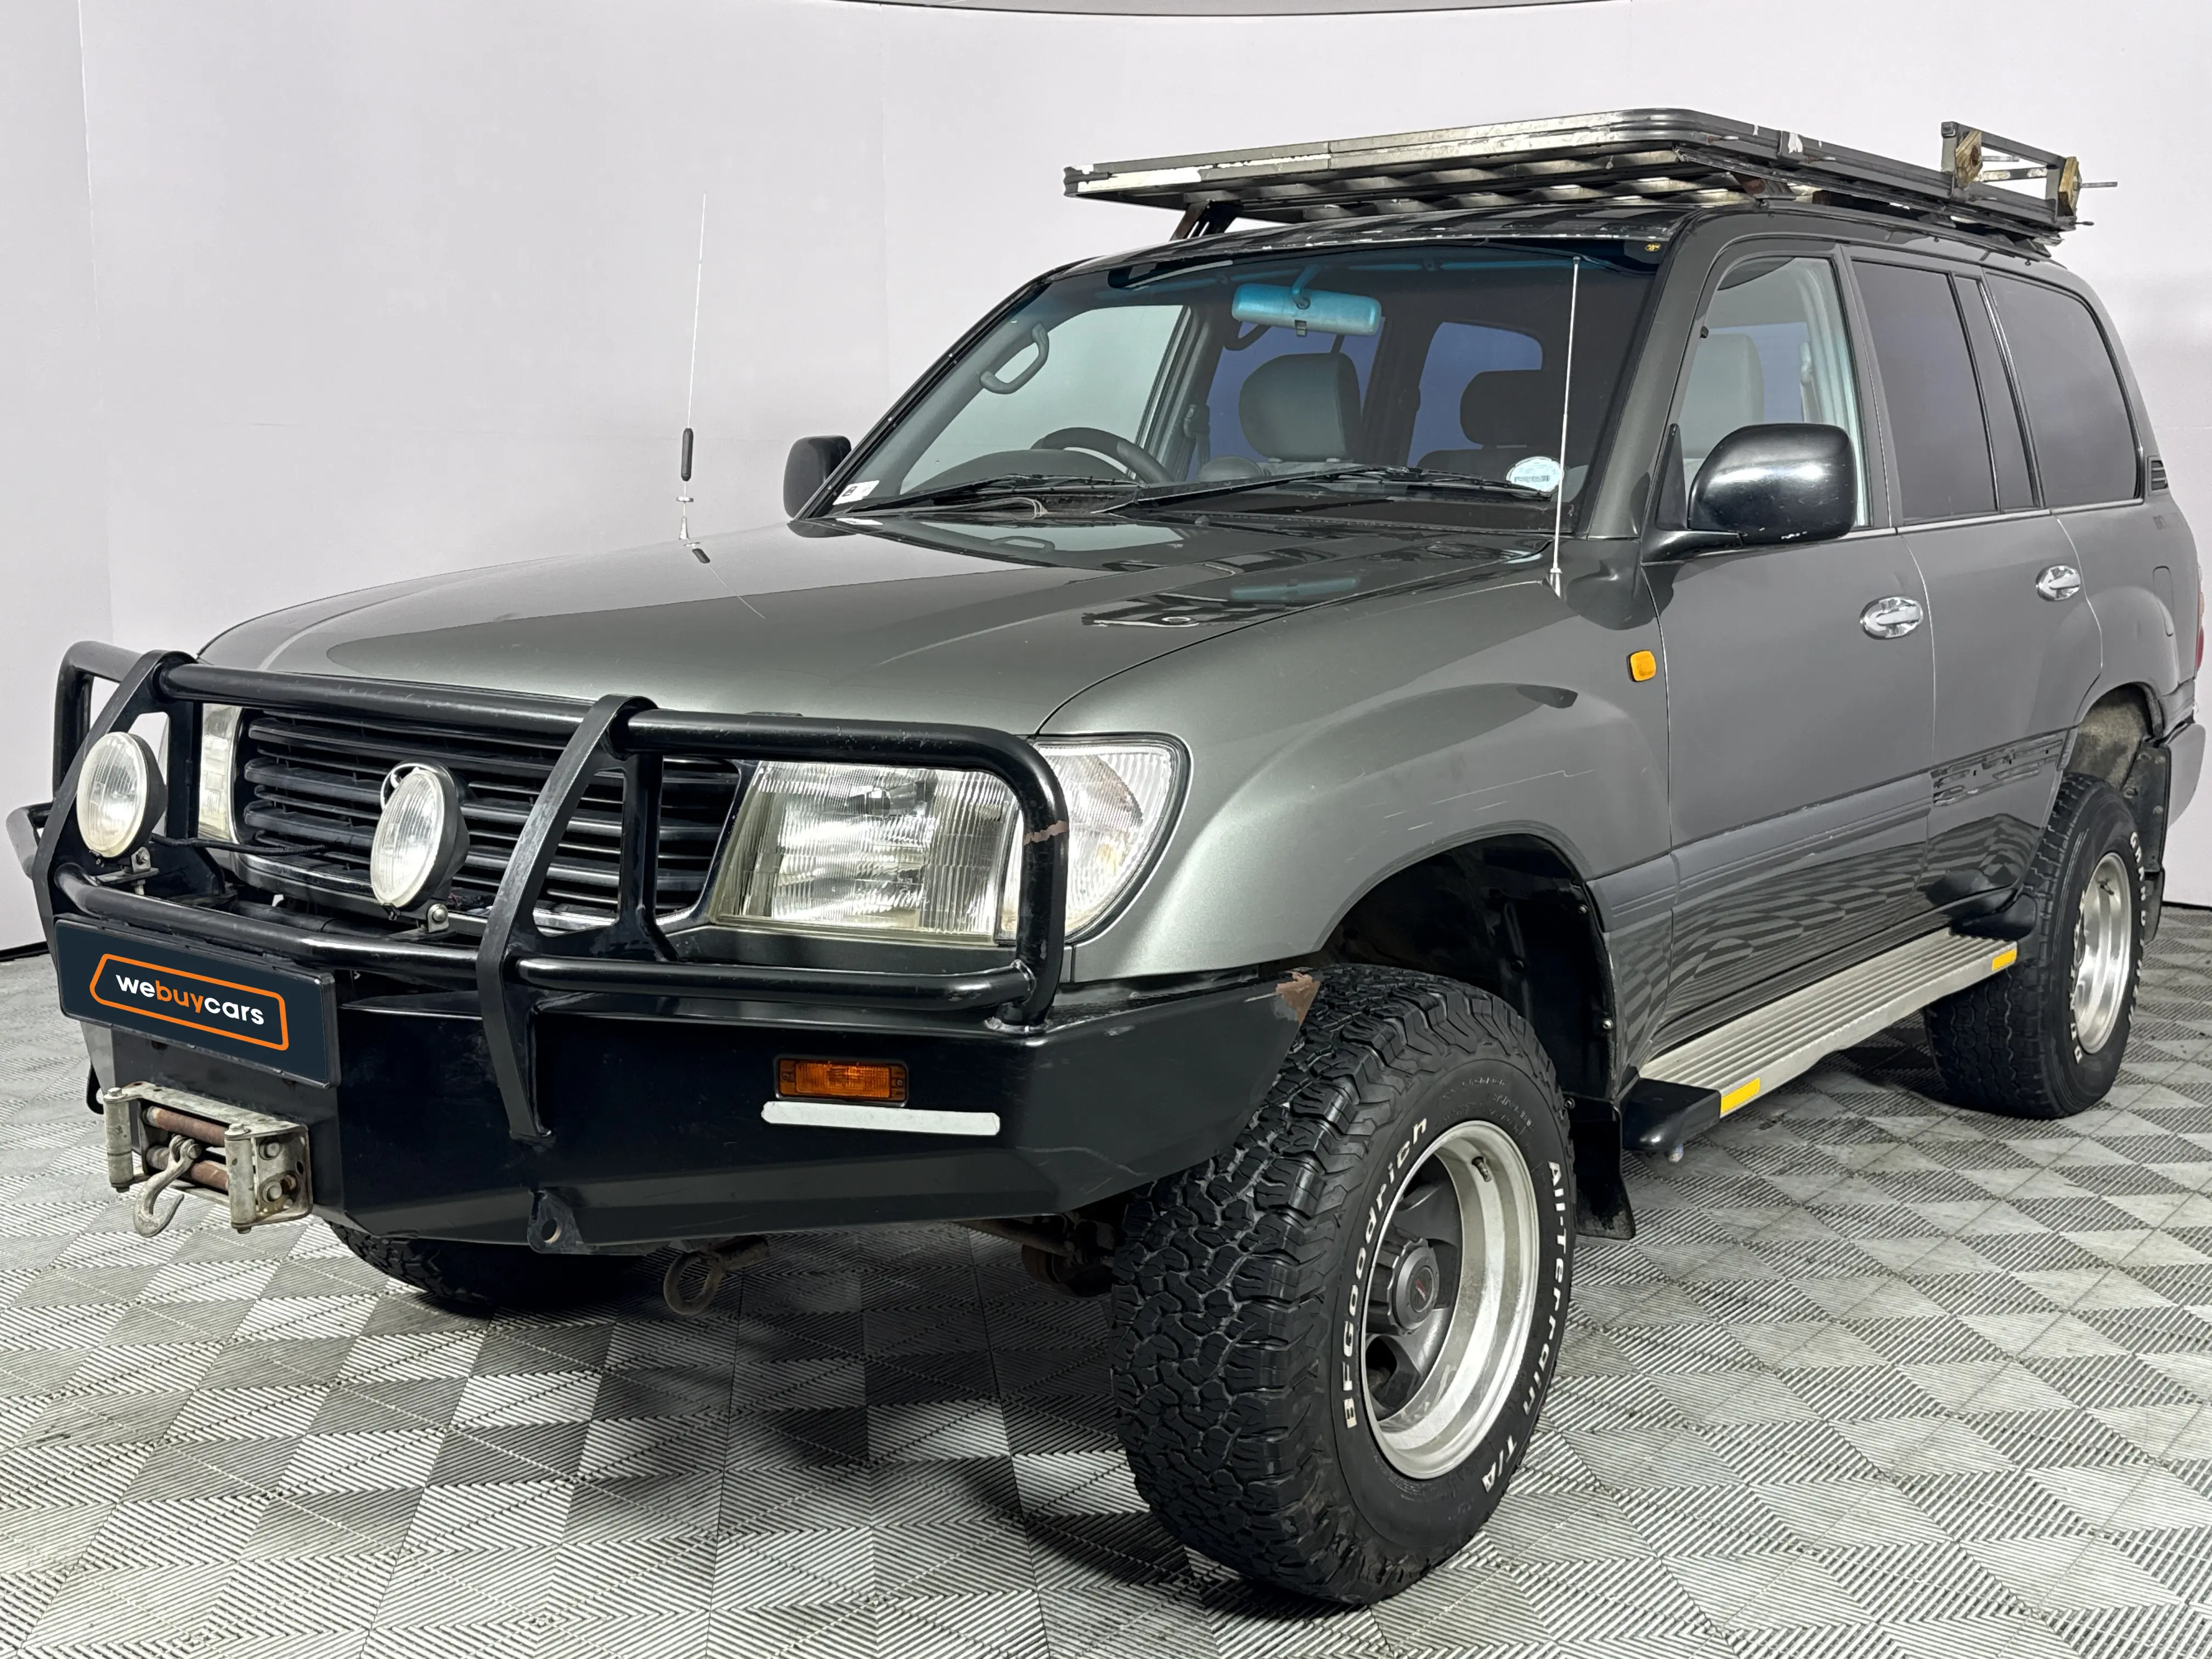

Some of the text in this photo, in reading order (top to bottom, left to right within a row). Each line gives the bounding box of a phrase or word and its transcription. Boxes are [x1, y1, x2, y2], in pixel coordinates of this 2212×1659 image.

[115, 974, 264, 1025] webuycars
[1342, 1118, 1427, 1429] BFGoodrich
[1482, 1161, 1567, 1492] All-Terrain T/A
